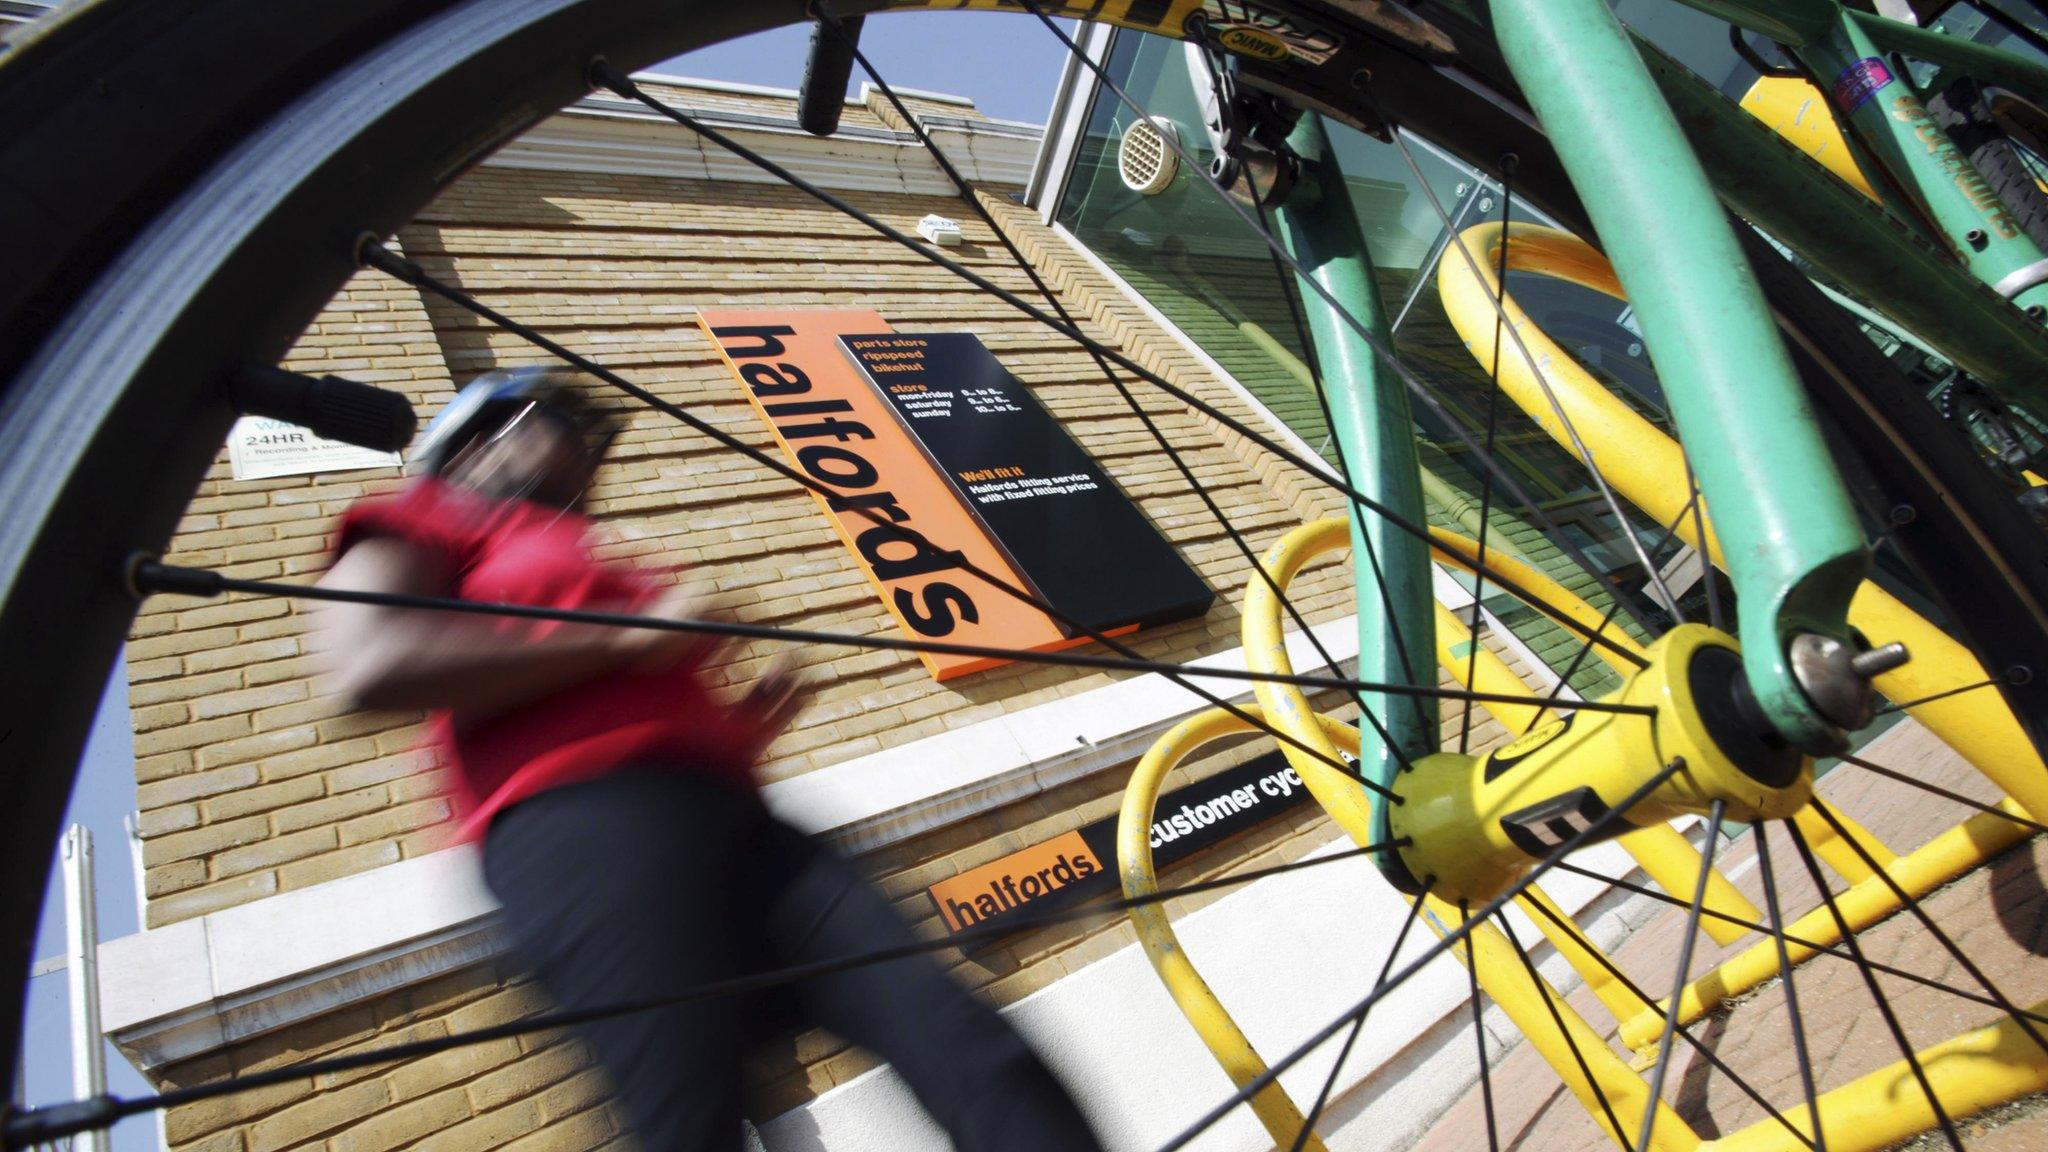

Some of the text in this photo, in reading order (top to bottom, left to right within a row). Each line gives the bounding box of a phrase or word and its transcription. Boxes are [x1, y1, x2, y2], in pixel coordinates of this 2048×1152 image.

[853, 338, 928, 350] parts store
[862, 350, 926, 362] ripspeed
[871, 362, 926, 373] bikehut
[889, 384, 928, 394] store
[897, 390, 954, 401] mon-friday
[975, 388, 988, 396] to
[904, 400, 953, 410] saturday
[982, 396, 995, 404] to
[912, 409, 951, 418] sunday
[246, 433, 304, 446] 24HR
[959, 466, 1025, 482] We'll fit it
[712, 325, 979, 638] halfords
[969, 473, 1090, 494] Halfords fitting service
[978, 482, 1099, 504] with fixed fitting prices
[945, 767, 1303, 932] halfords customer cyc
